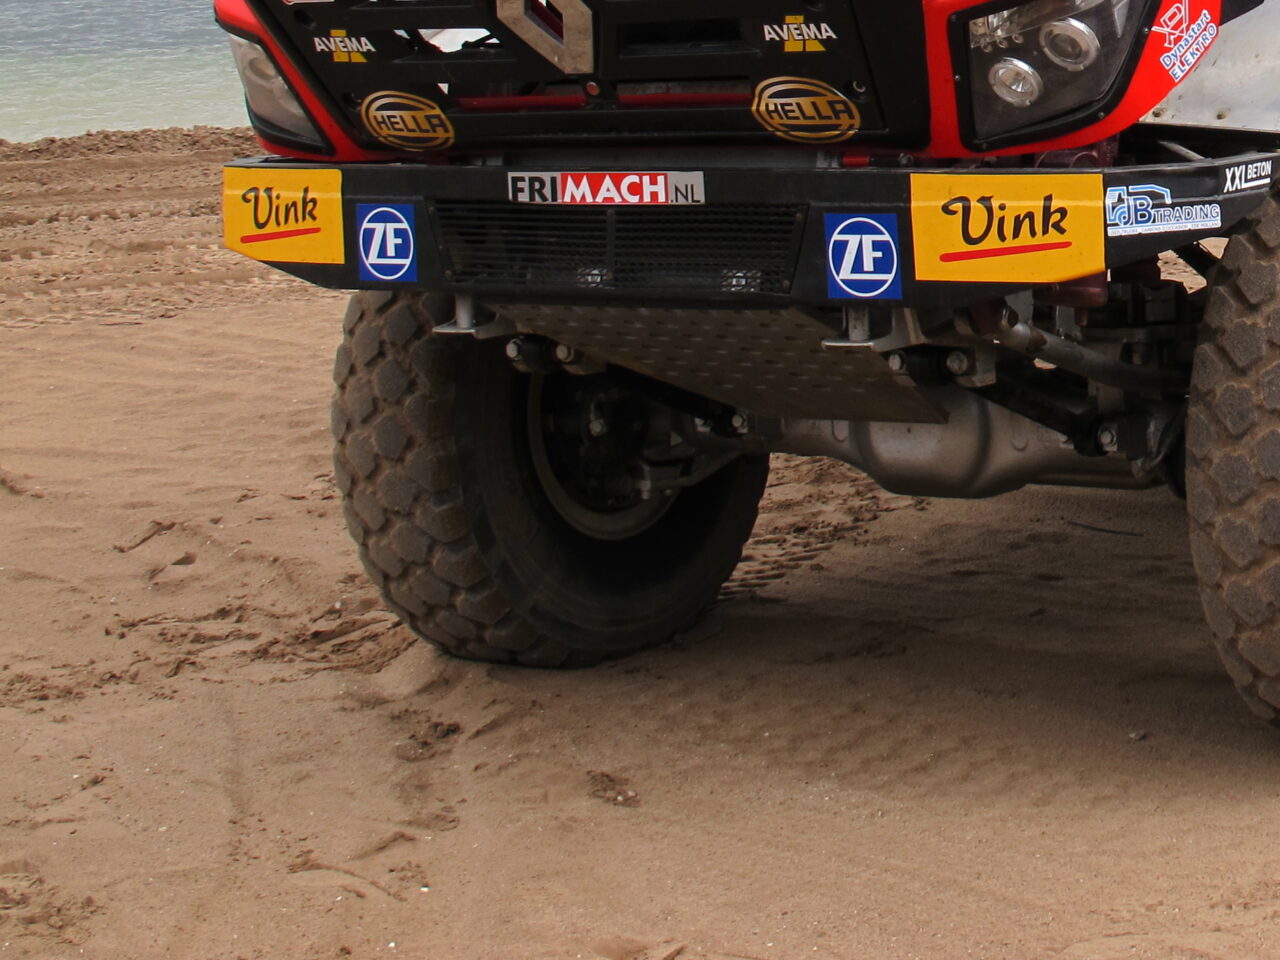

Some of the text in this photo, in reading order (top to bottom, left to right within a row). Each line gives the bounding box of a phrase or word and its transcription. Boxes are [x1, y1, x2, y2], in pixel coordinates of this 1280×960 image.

[313, 36, 376, 53] AVEMA
[763, 22, 838, 41] AVEMA
[1160, 10, 1211, 69] Dynastart
[1169, 24, 1217, 81] ELEKTRO
[373, 114, 450, 134] HELLA
[765, 99, 855, 121] HELLA
[1224, 159, 1272, 193] XXL BETON
[241, 186, 319, 230] Vink
[941, 194, 1069, 246] Vink
[1154, 203, 1221, 224] TRADING
[363, 223, 408, 264] ZF
[832, 234, 891, 280] ZF
